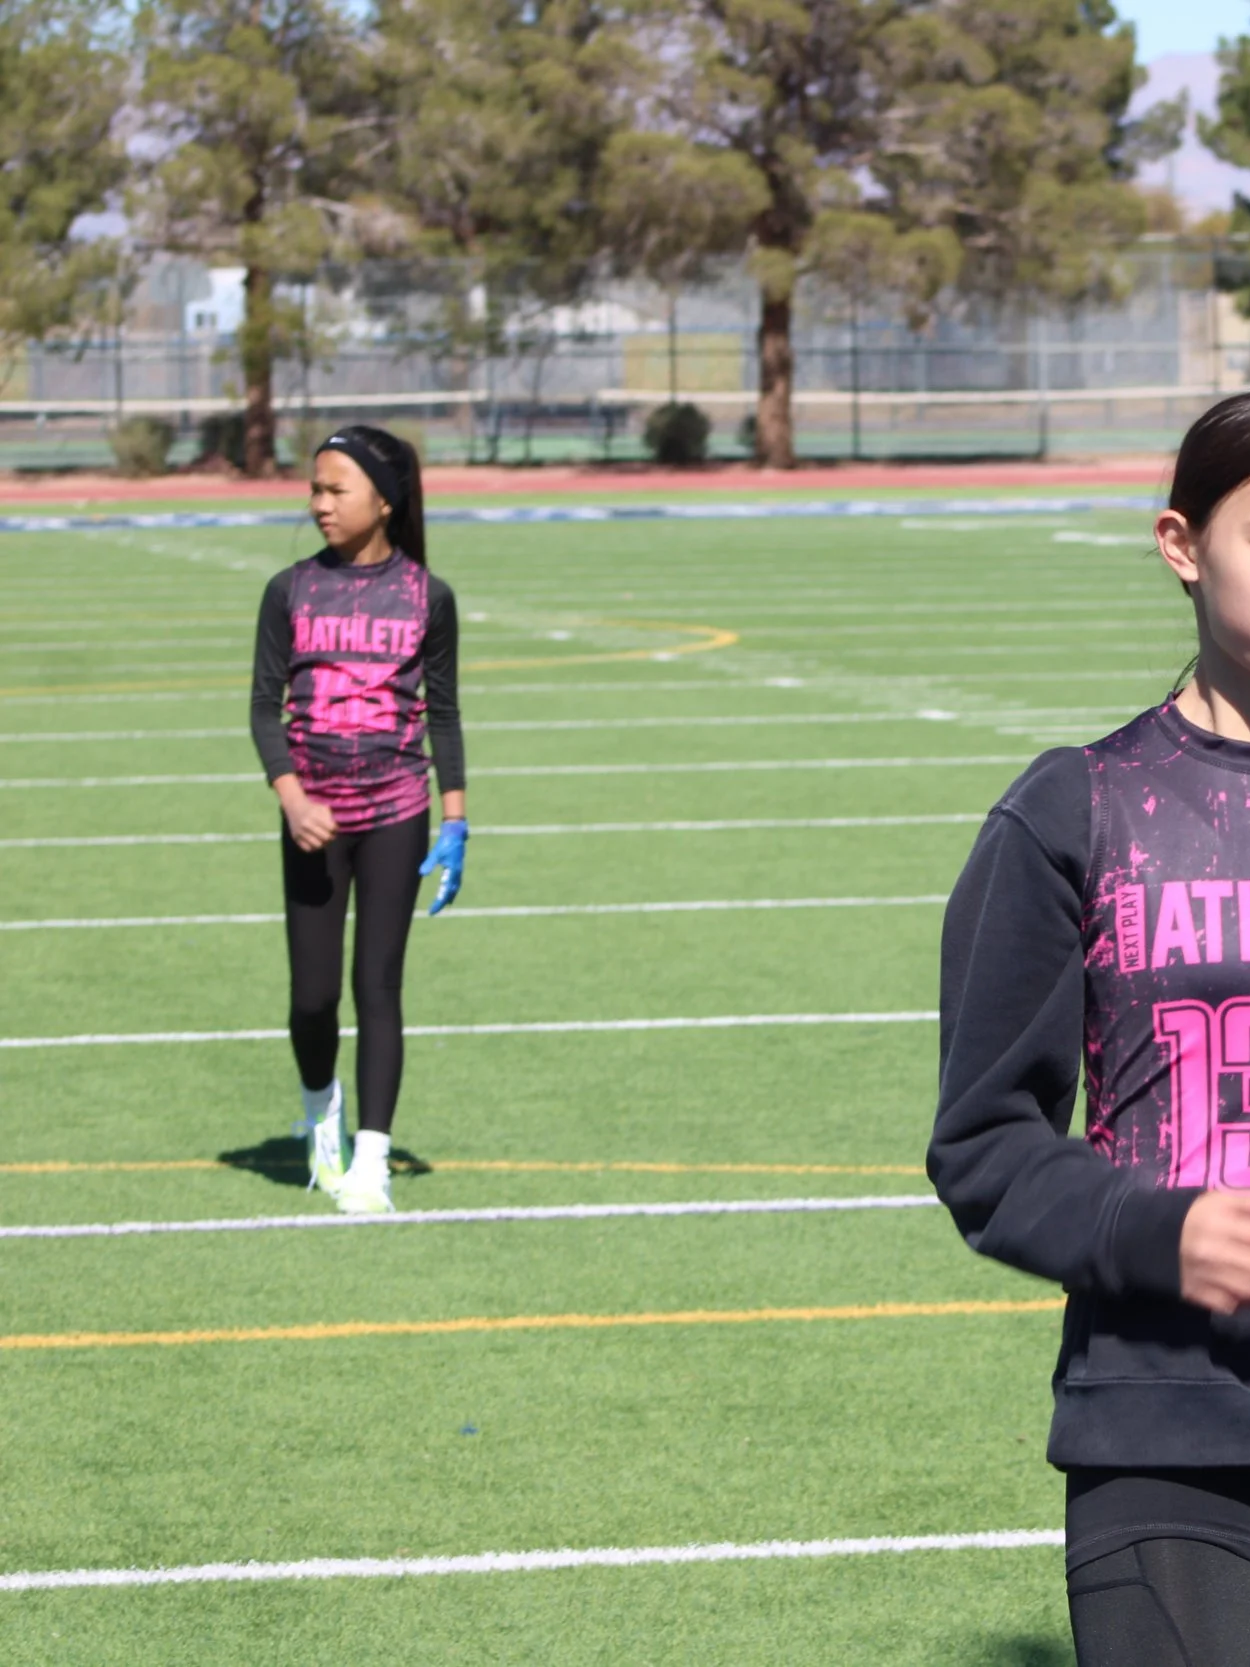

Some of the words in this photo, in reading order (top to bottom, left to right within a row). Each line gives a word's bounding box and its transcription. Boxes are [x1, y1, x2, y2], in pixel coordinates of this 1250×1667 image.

[311, 615, 419, 656] ATHLETE
[1120, 891, 1139, 928] PLAY
[1122, 932, 1140, 969] NEXT
